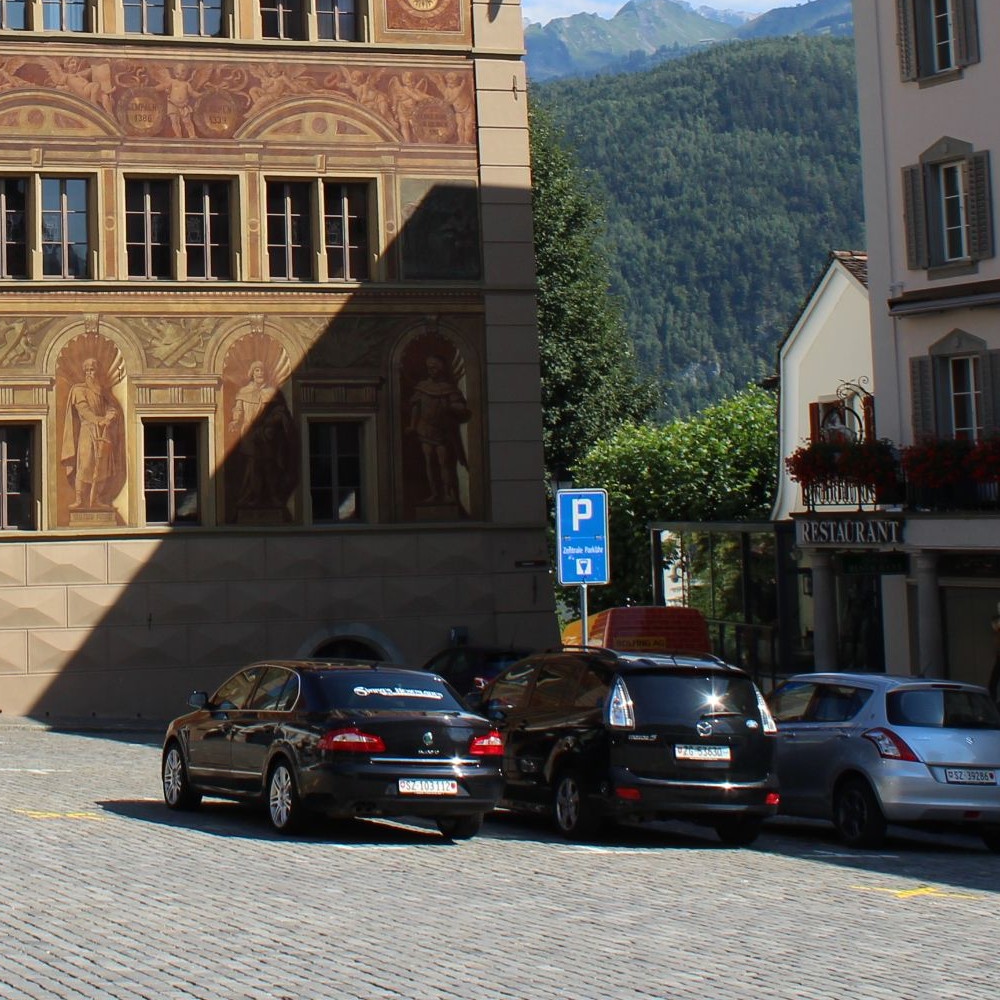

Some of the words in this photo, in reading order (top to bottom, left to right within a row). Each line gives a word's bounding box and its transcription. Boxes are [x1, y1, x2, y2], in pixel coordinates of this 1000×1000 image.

[572, 499, 592, 531] P
[803, 521, 899, 542] RESTAURANT
[563, 546, 583, 554] Zentrale
